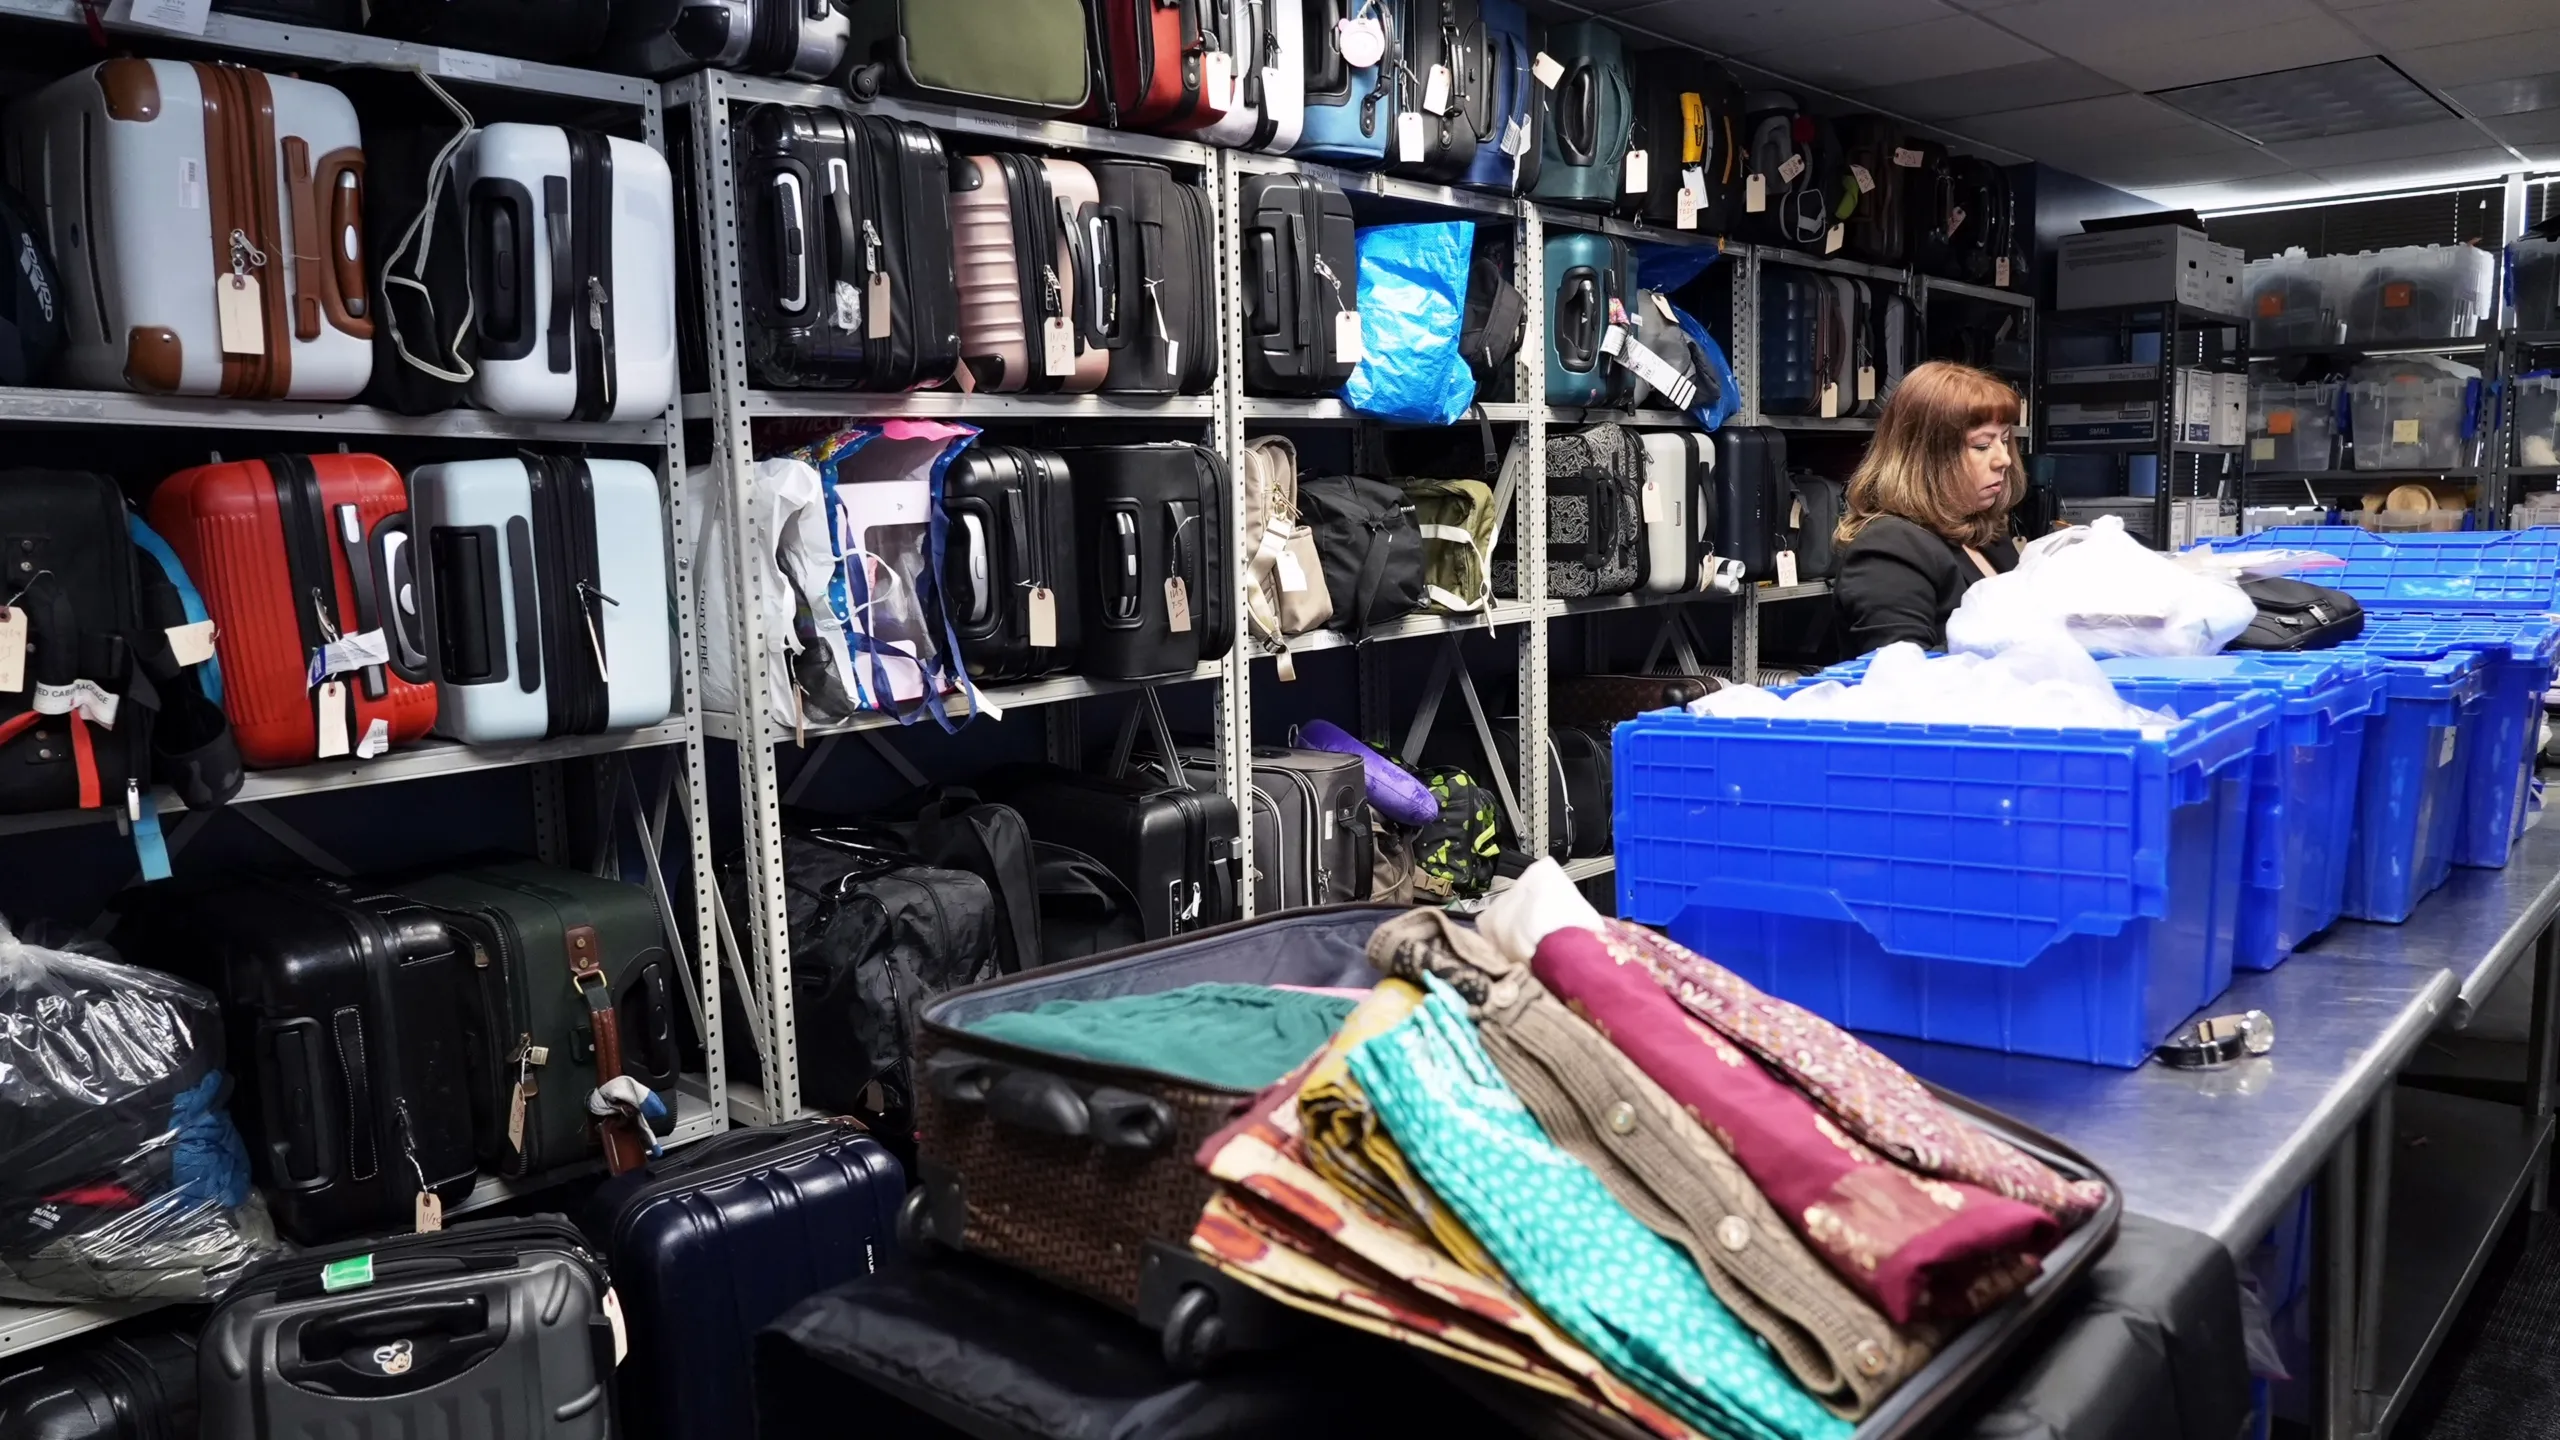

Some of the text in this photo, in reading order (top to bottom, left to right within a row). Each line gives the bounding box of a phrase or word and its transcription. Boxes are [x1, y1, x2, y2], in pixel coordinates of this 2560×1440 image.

[973, 116, 1009, 129] TERMINAL
[21, 232, 53, 322] adidas
[699, 590, 707, 632] DUTY
[37, 687, 49, 697] ED
